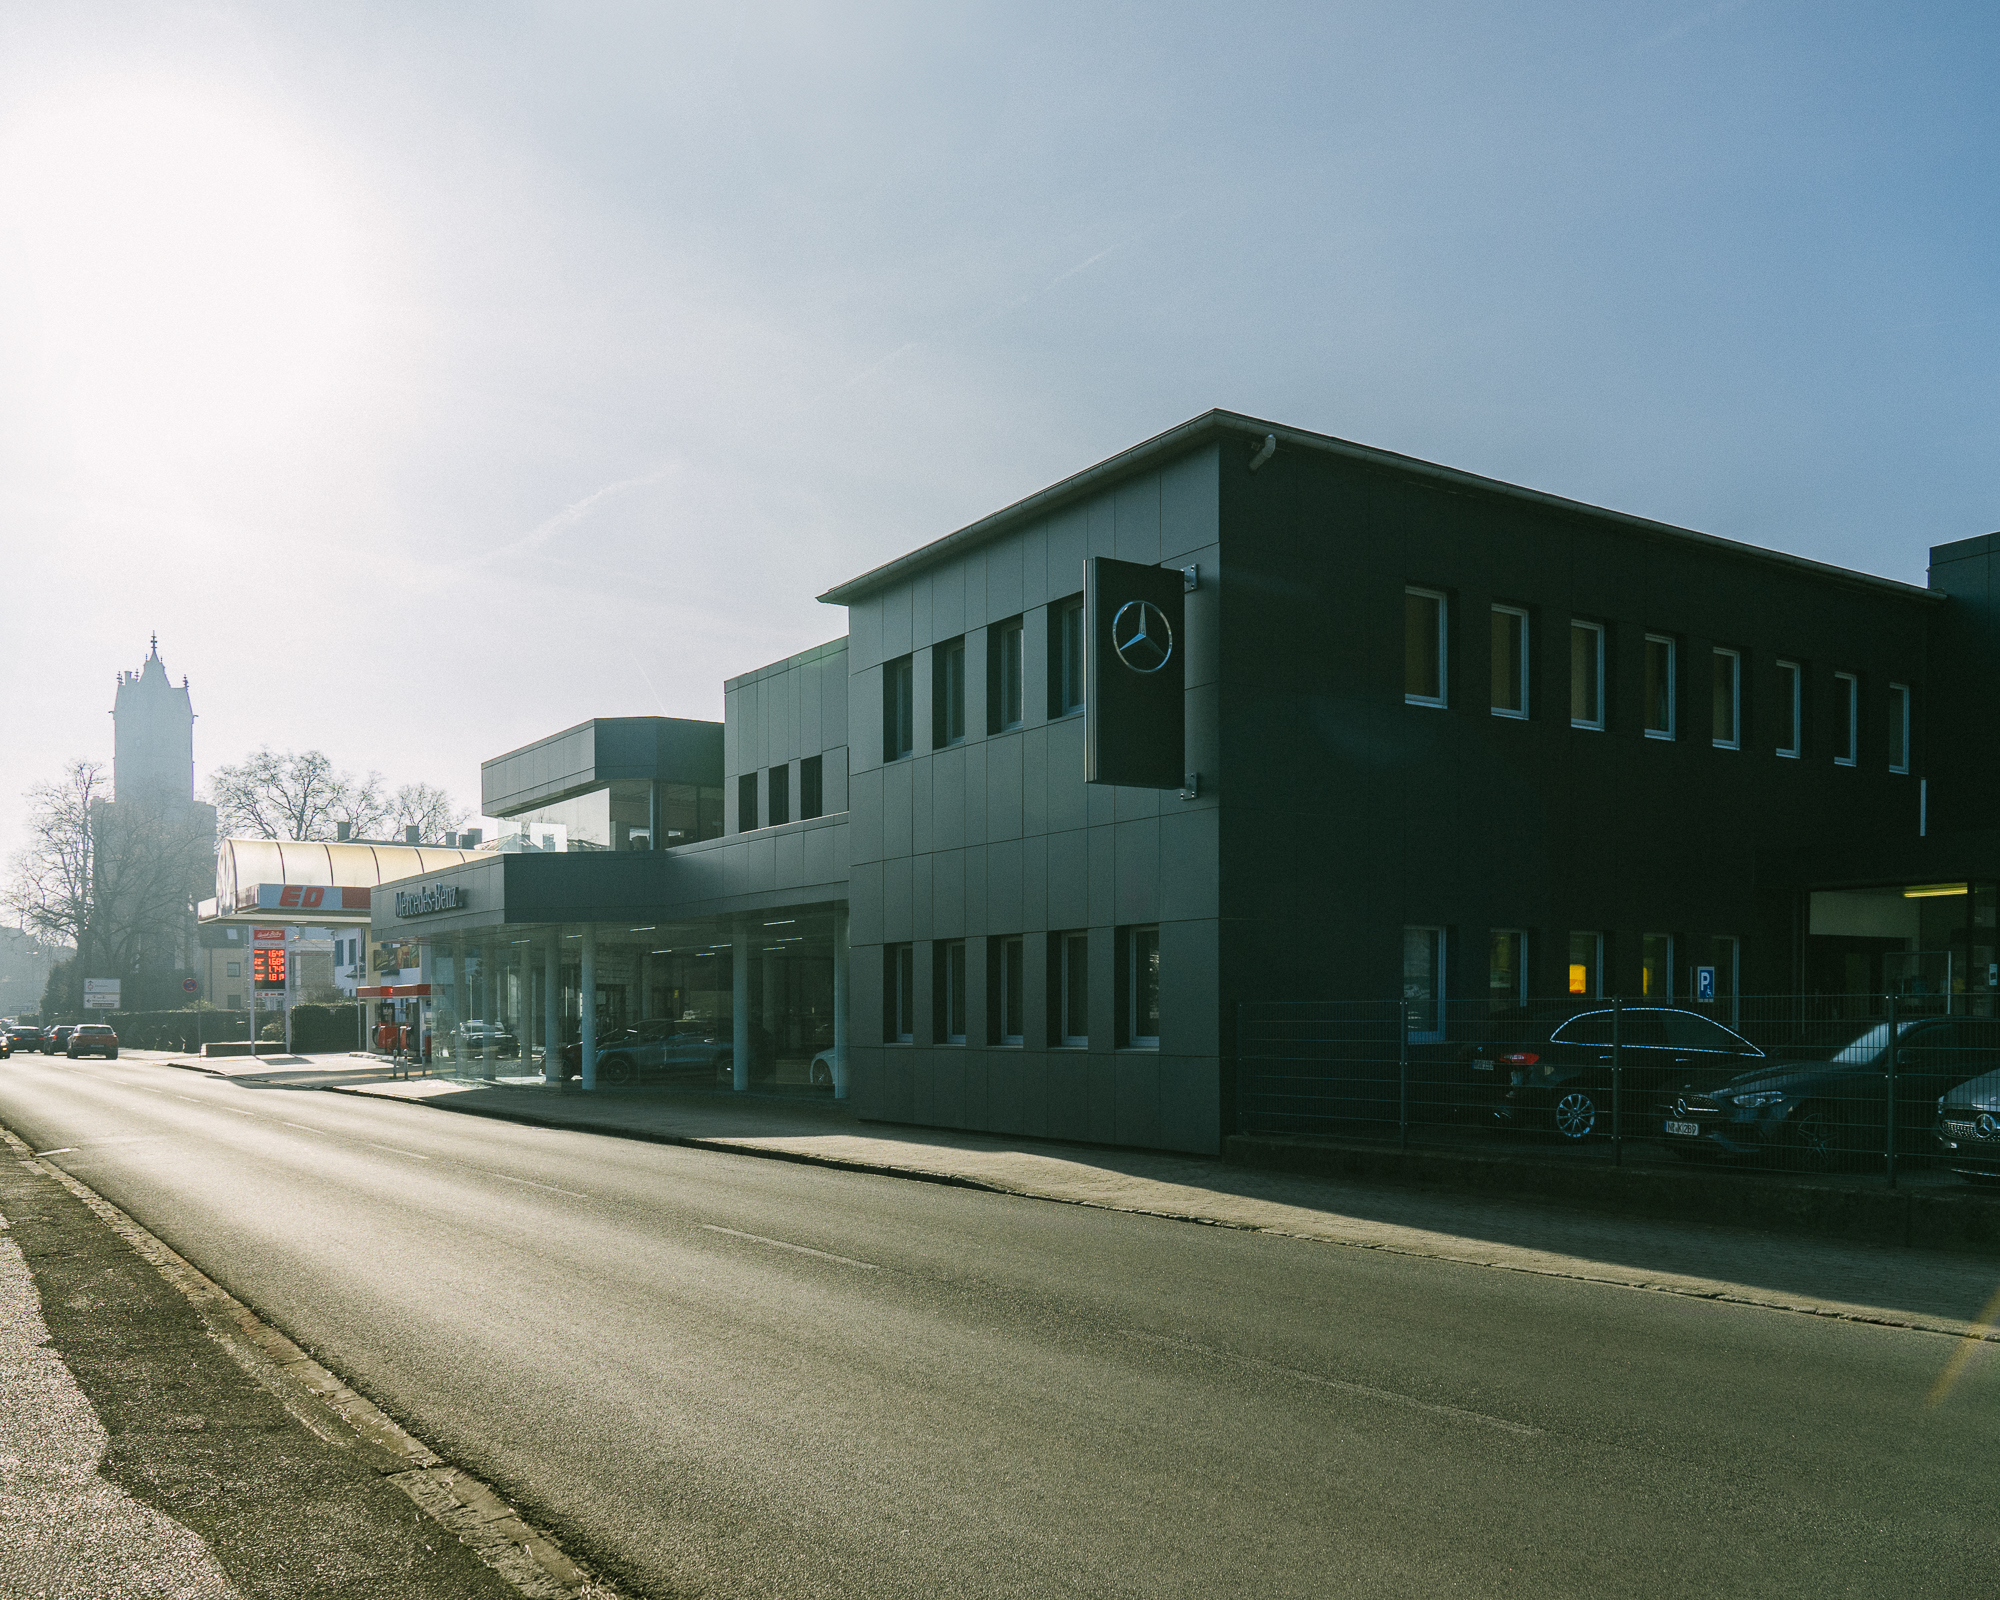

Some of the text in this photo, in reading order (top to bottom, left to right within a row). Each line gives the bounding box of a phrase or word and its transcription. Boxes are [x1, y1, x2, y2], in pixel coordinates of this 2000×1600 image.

[279, 886, 325, 908] ED
[395, 882, 459, 918] Mercedes-Benz
[1701, 972, 1710, 991] P
